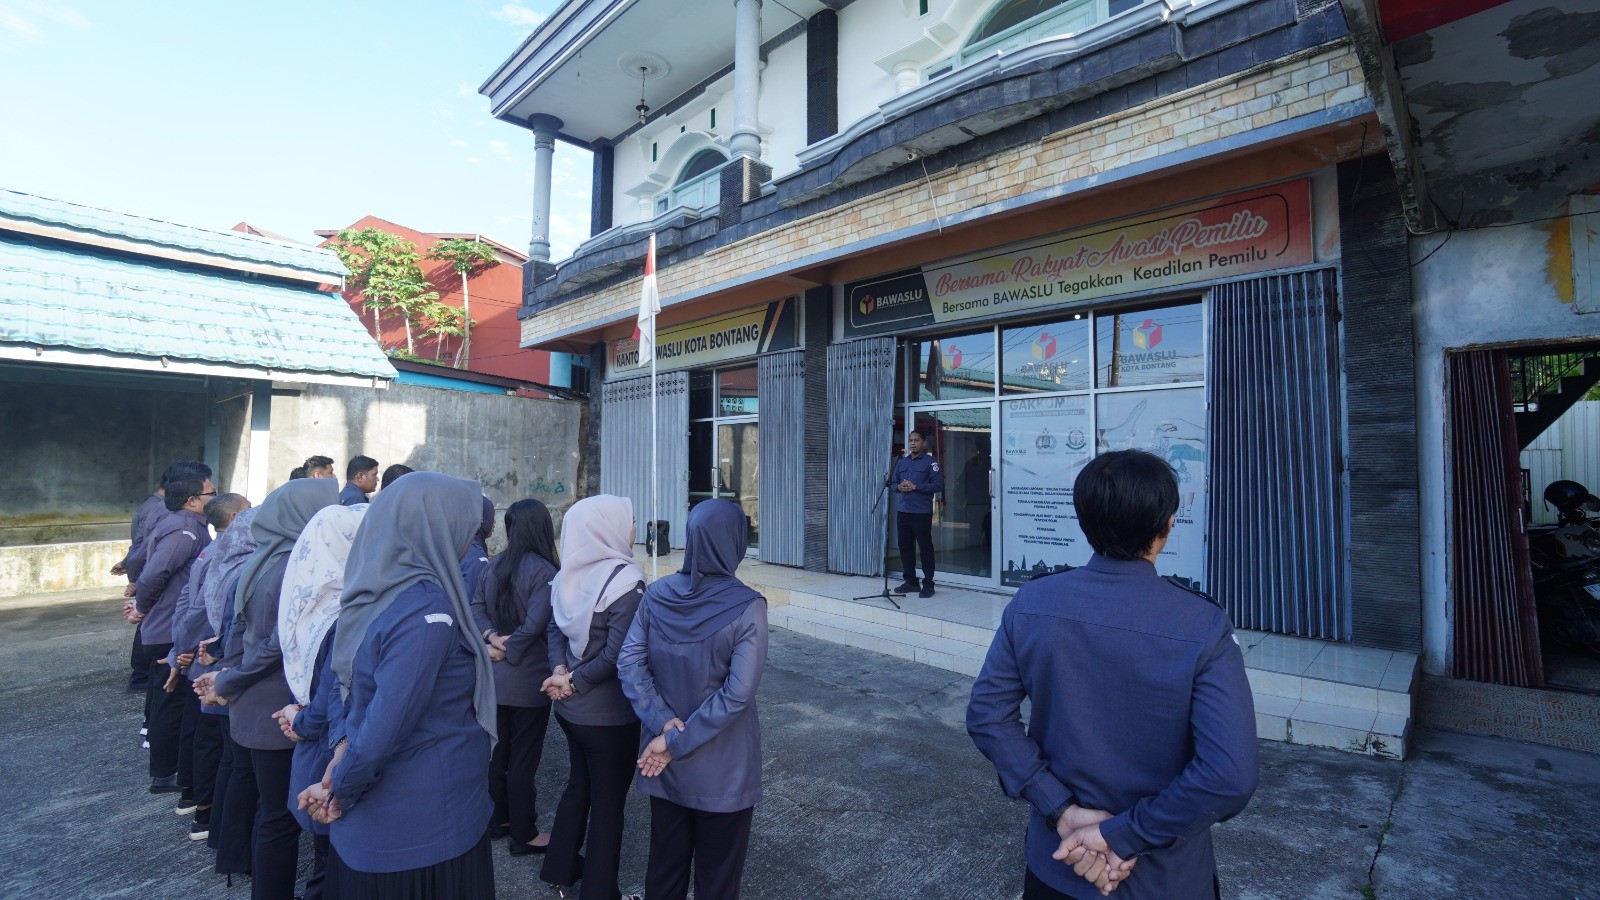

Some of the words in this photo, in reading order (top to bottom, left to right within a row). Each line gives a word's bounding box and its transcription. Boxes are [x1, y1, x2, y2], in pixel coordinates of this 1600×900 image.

[934, 272, 1008, 297] Bersama
[1010, 247, 1088, 283] Rakyat
[1086, 229, 1170, 269] Awasi
[1171, 211, 1267, 254] Pemilu
[942, 297, 989, 313] Bersama
[993, 284, 1053, 305] BAWASLU
[1058, 274, 1123, 295] Tegakkan
[1133, 259, 1203, 281] Keadilan
[1209, 246, 1268, 268] Pemilu
[876, 289, 923, 308] BAWASLU
[616, 349, 640, 368] KANTO
[655, 341, 682, 360] WASLU
[684, 335, 708, 354] KOTA
[709, 323, 760, 350] BONTANG
[1120, 350, 1177, 364] BAWASLU
[1121, 364, 1140, 372] KOTA
[1141, 362, 1177, 370] BONTANG
